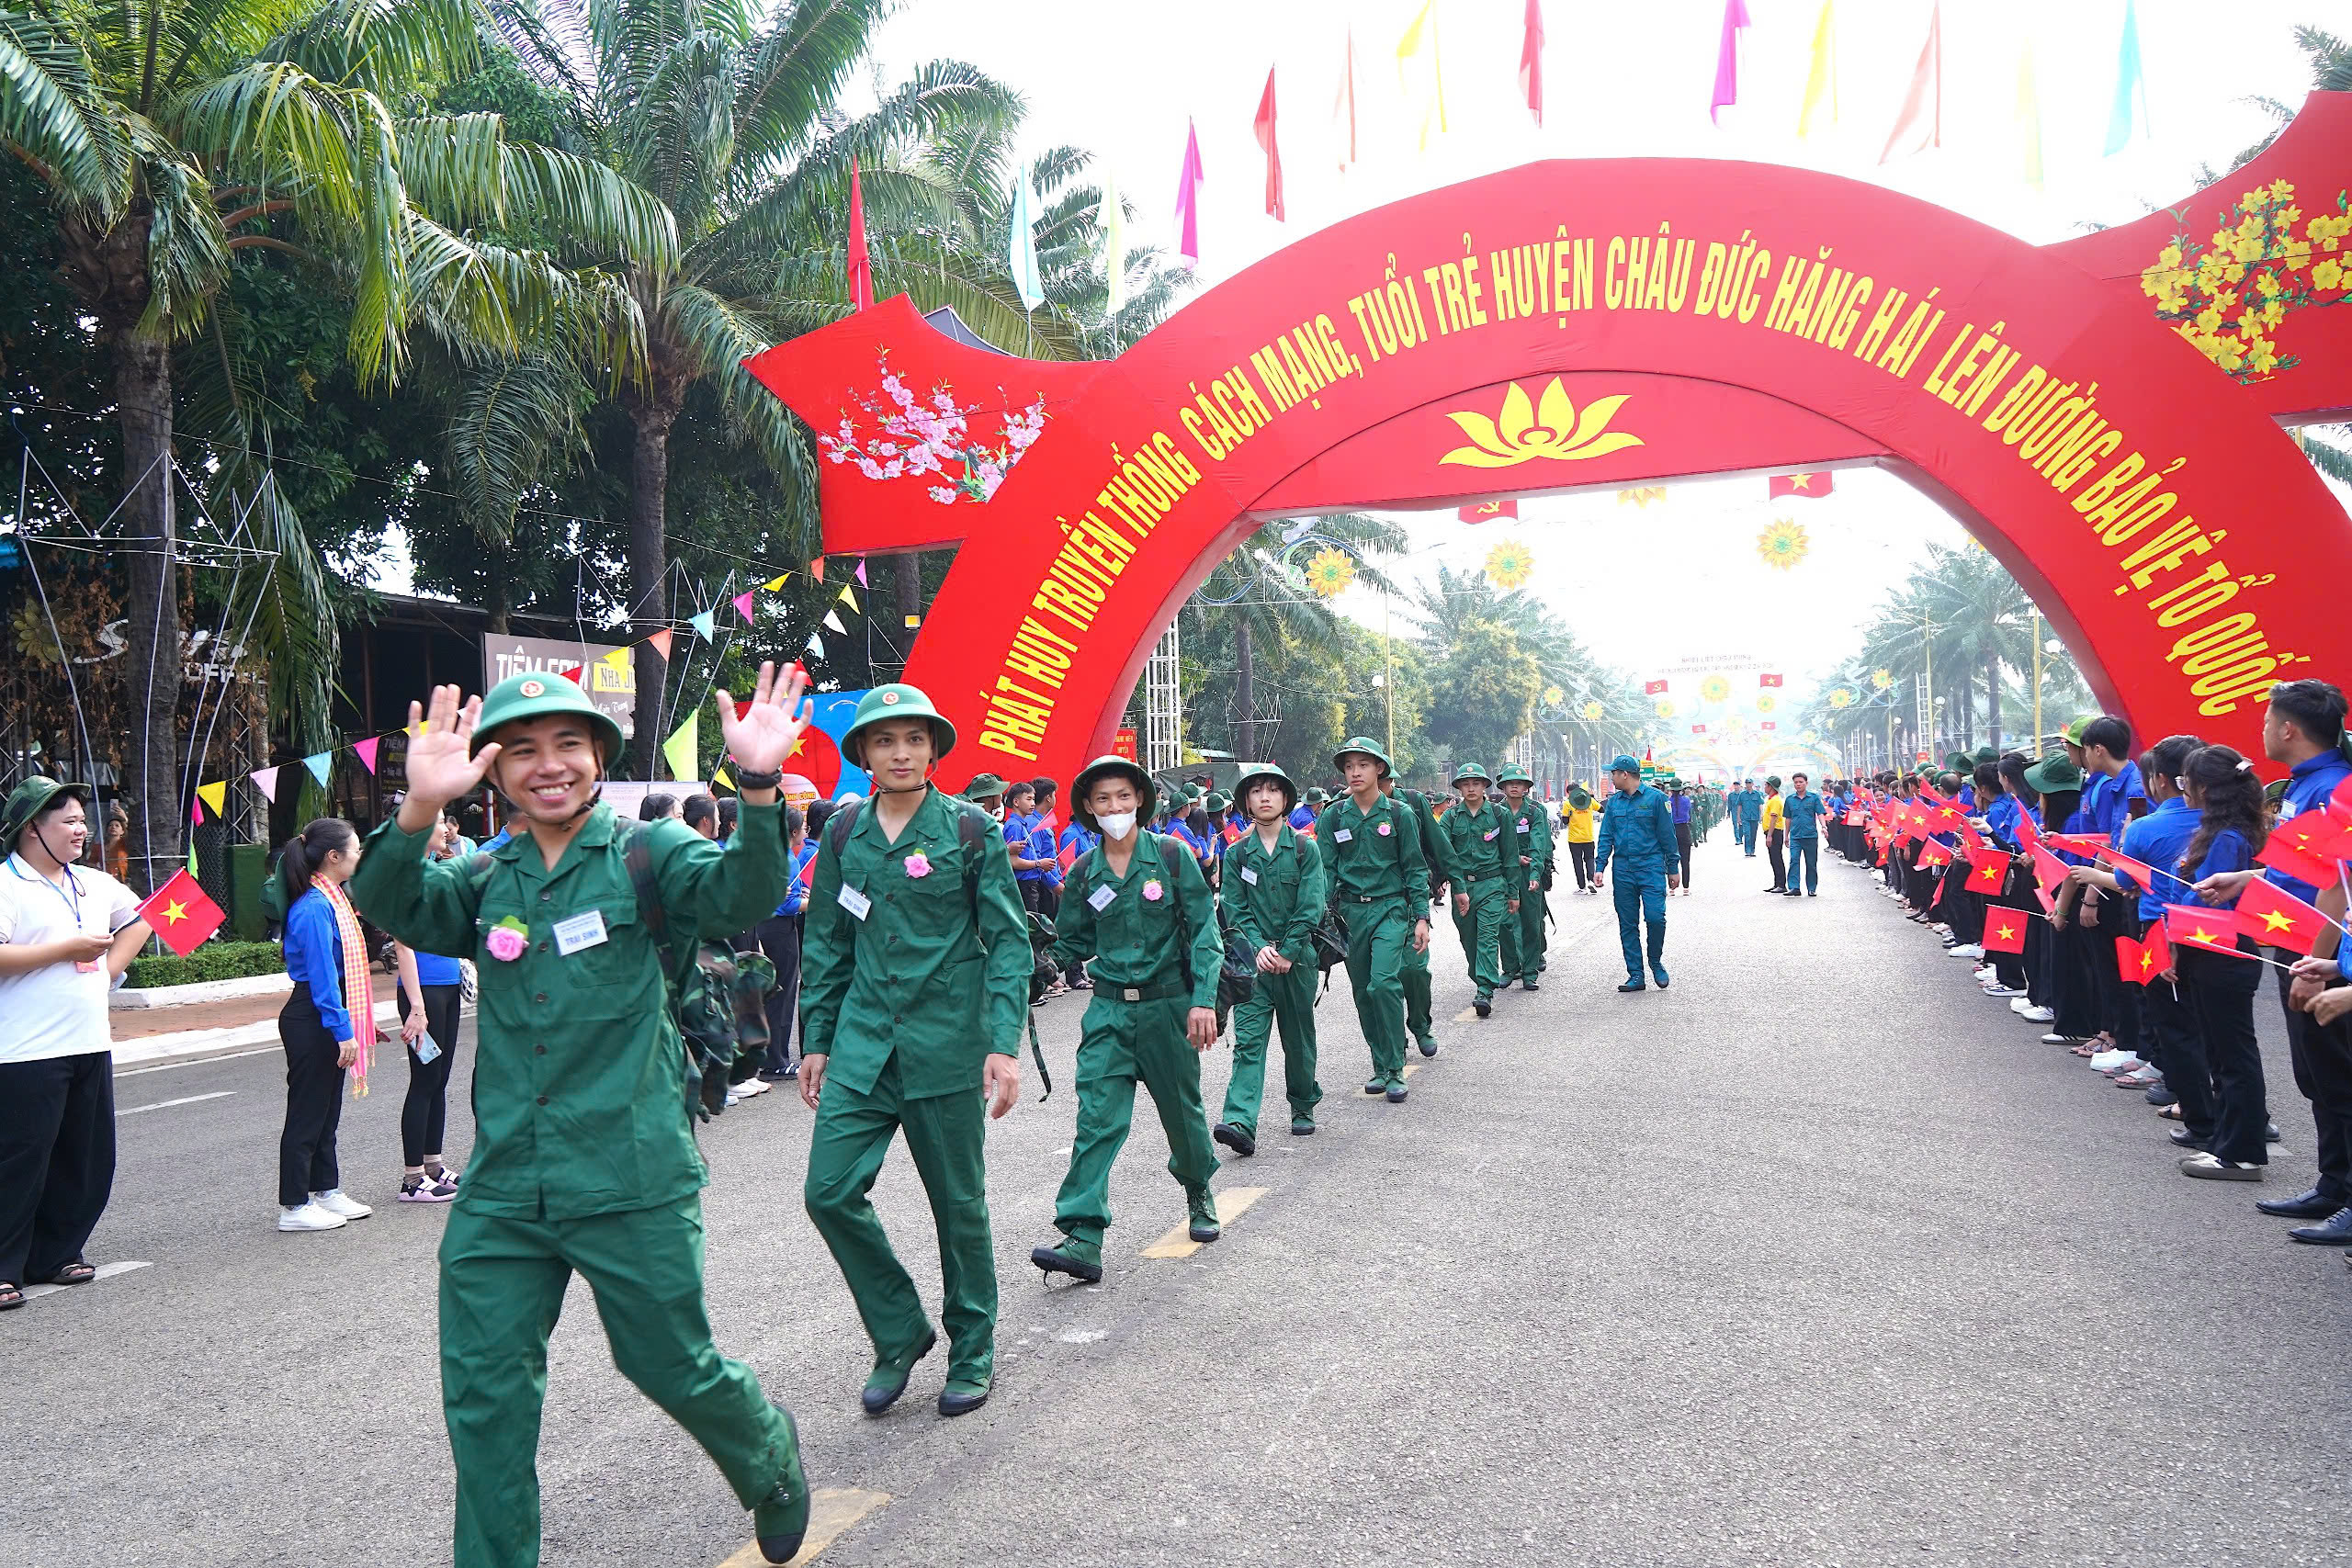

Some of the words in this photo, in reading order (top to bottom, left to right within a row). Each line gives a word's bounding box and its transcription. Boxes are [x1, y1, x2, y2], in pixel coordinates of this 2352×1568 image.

[1348, 252, 1430, 362] TUỔI
[1423, 231, 1488, 335] TRẺ
[1490, 224, 1595, 330] HUYỆN
[1605, 220, 1696, 313] CHÂU
[1693, 228, 1772, 324] ĐỨC
[1764, 245, 1875, 351] HĂNG
[1250, 313, 1363, 412] MẠNG,
[1923, 320, 2022, 418] LÊN
[1179, 367, 1272, 461] CÁCH
[1981, 364, 2123, 493] ĐƯỜNG
[1096, 431, 1203, 537] THỐNG
[2070, 451, 2188, 547] BẢO
[1032, 511, 1137, 632] TRUYỀN
[2113, 514, 2228, 596] VỆ
[2147, 560, 2277, 627] TỔ
[1005, 615, 1079, 690] HUY
[2165, 612, 2312, 717] QUỐC
[978, 676, 1055, 761] PHÁT
